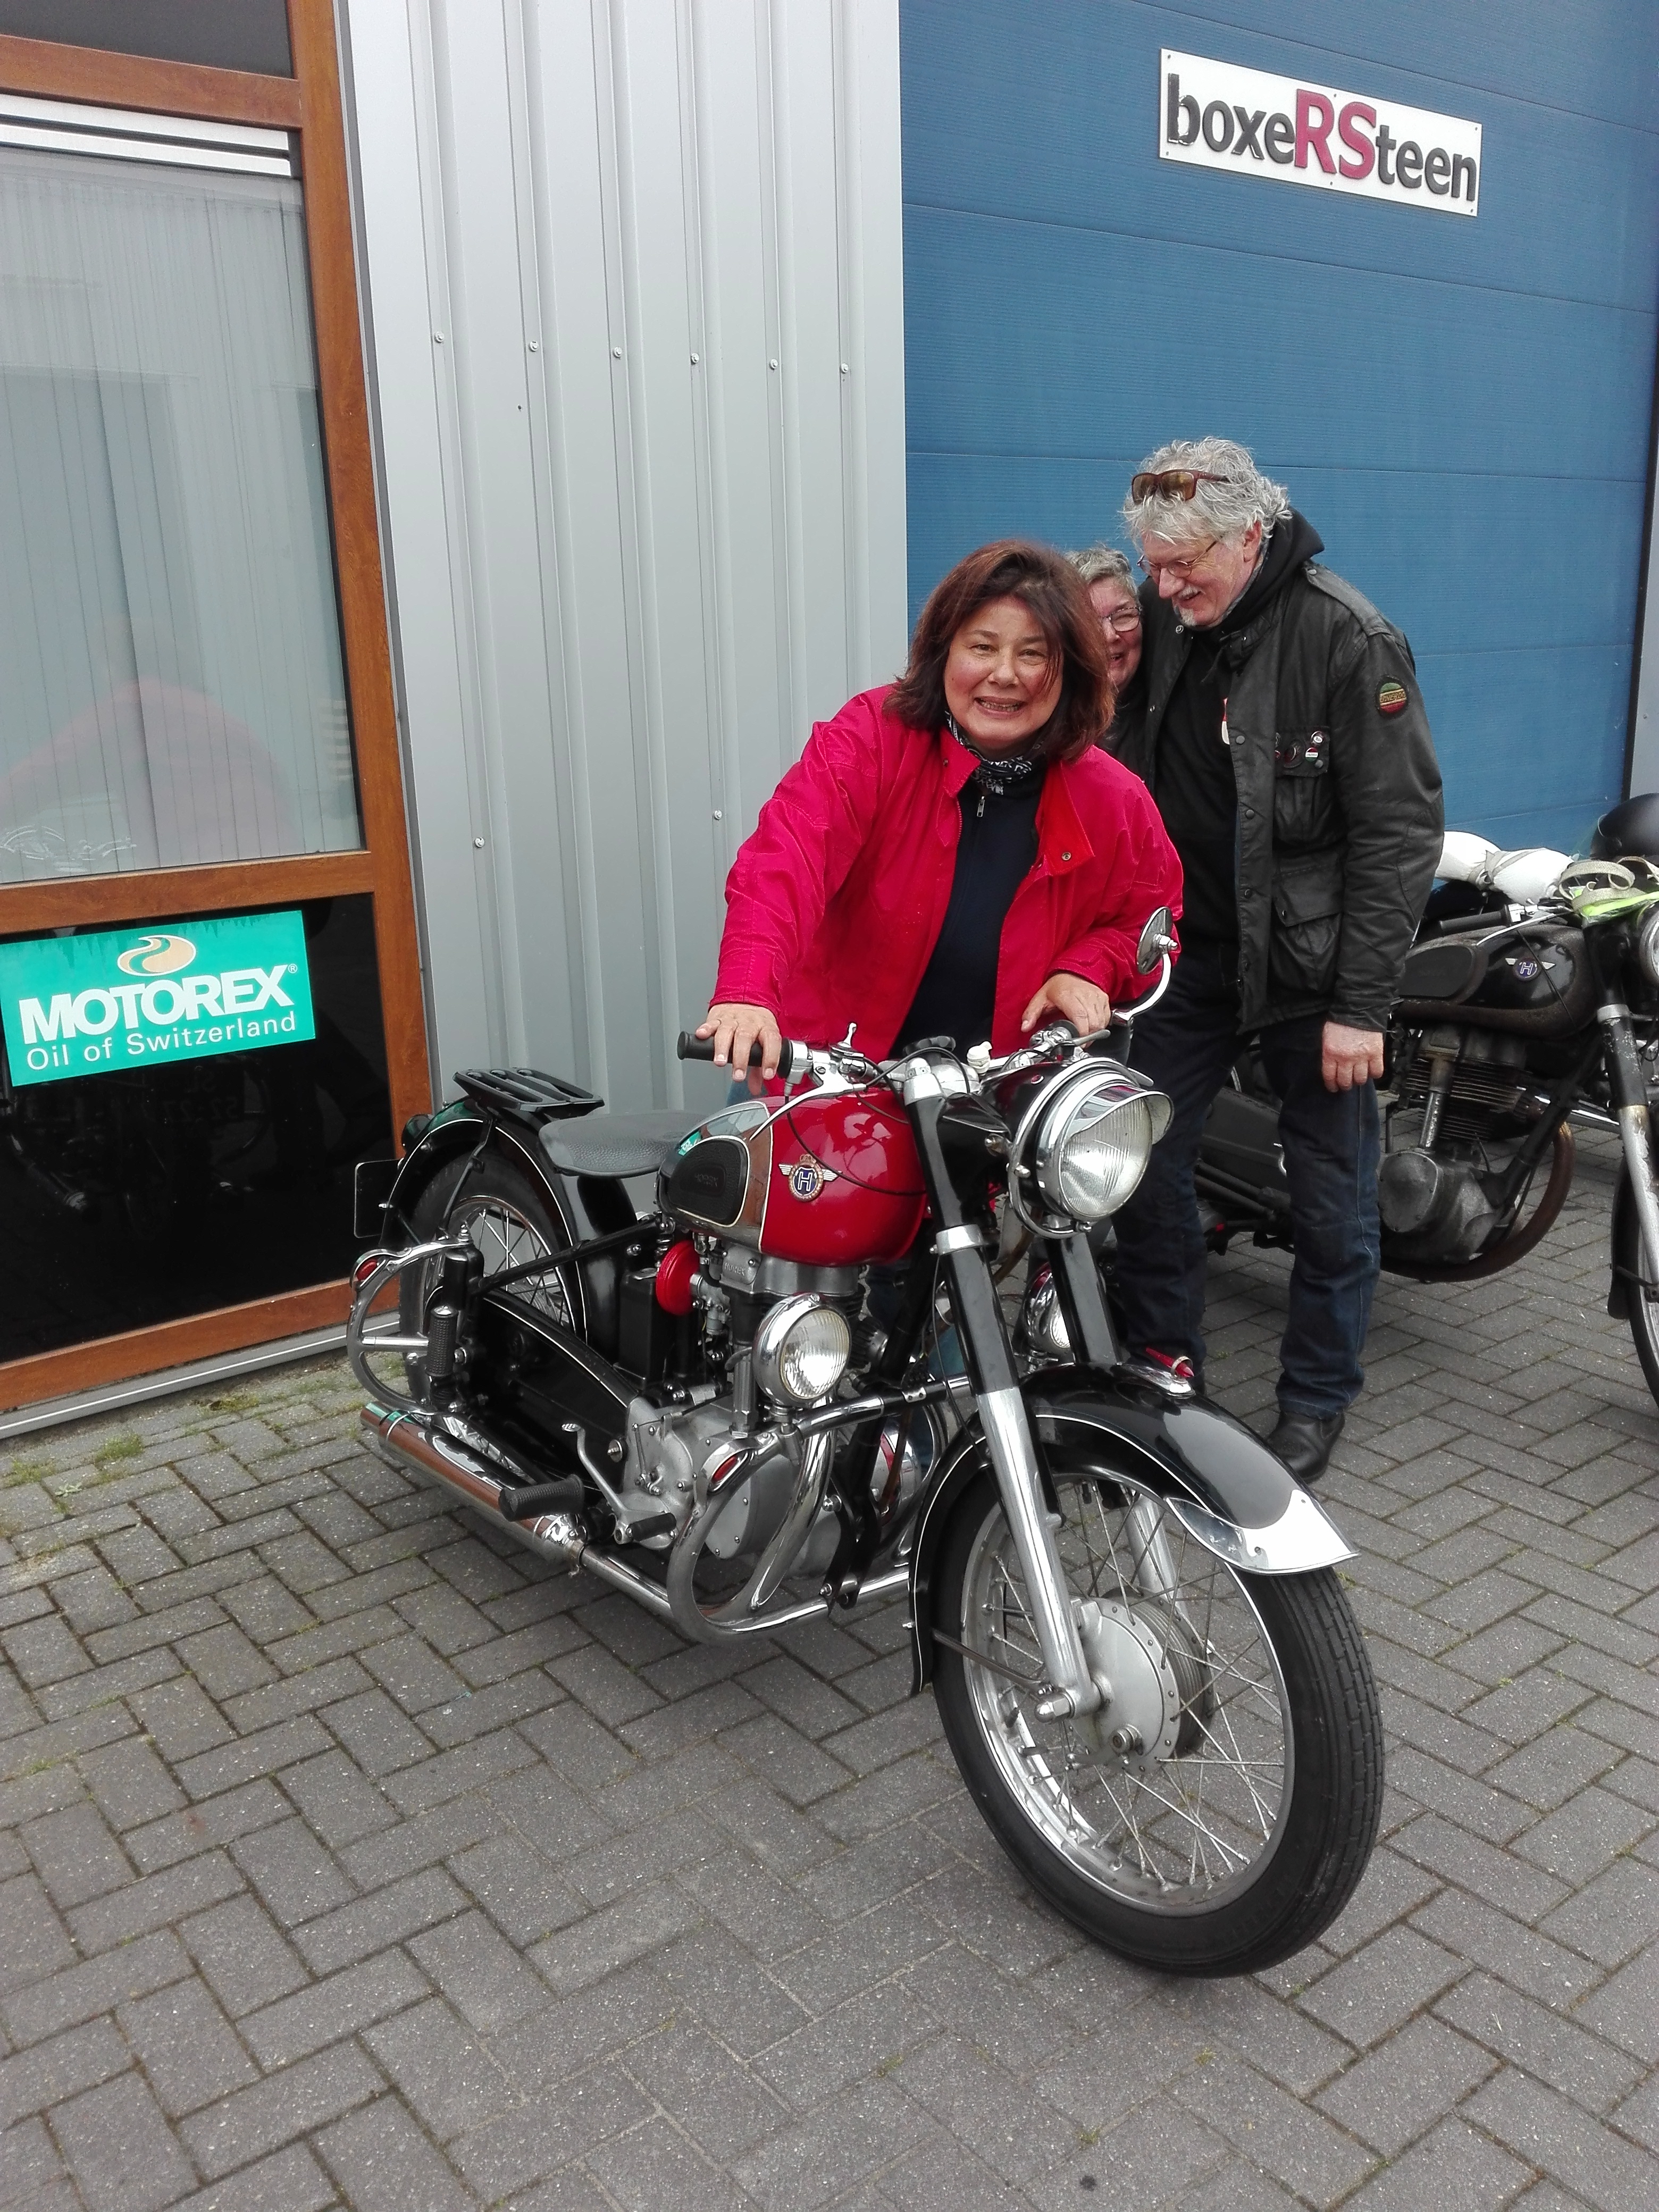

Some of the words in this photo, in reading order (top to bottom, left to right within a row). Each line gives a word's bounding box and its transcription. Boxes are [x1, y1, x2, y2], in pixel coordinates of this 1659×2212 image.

[1167, 73, 1477, 202] boxeRSteen
[1520, 962, 1534, 975] H
[18, 964, 295, 1045] MOTOREX
[27, 1044, 69, 1070] Oil
[83, 1036, 113, 1062] of
[126, 1010, 296, 1055] Switzerland
[797, 1171, 813, 1192] H
